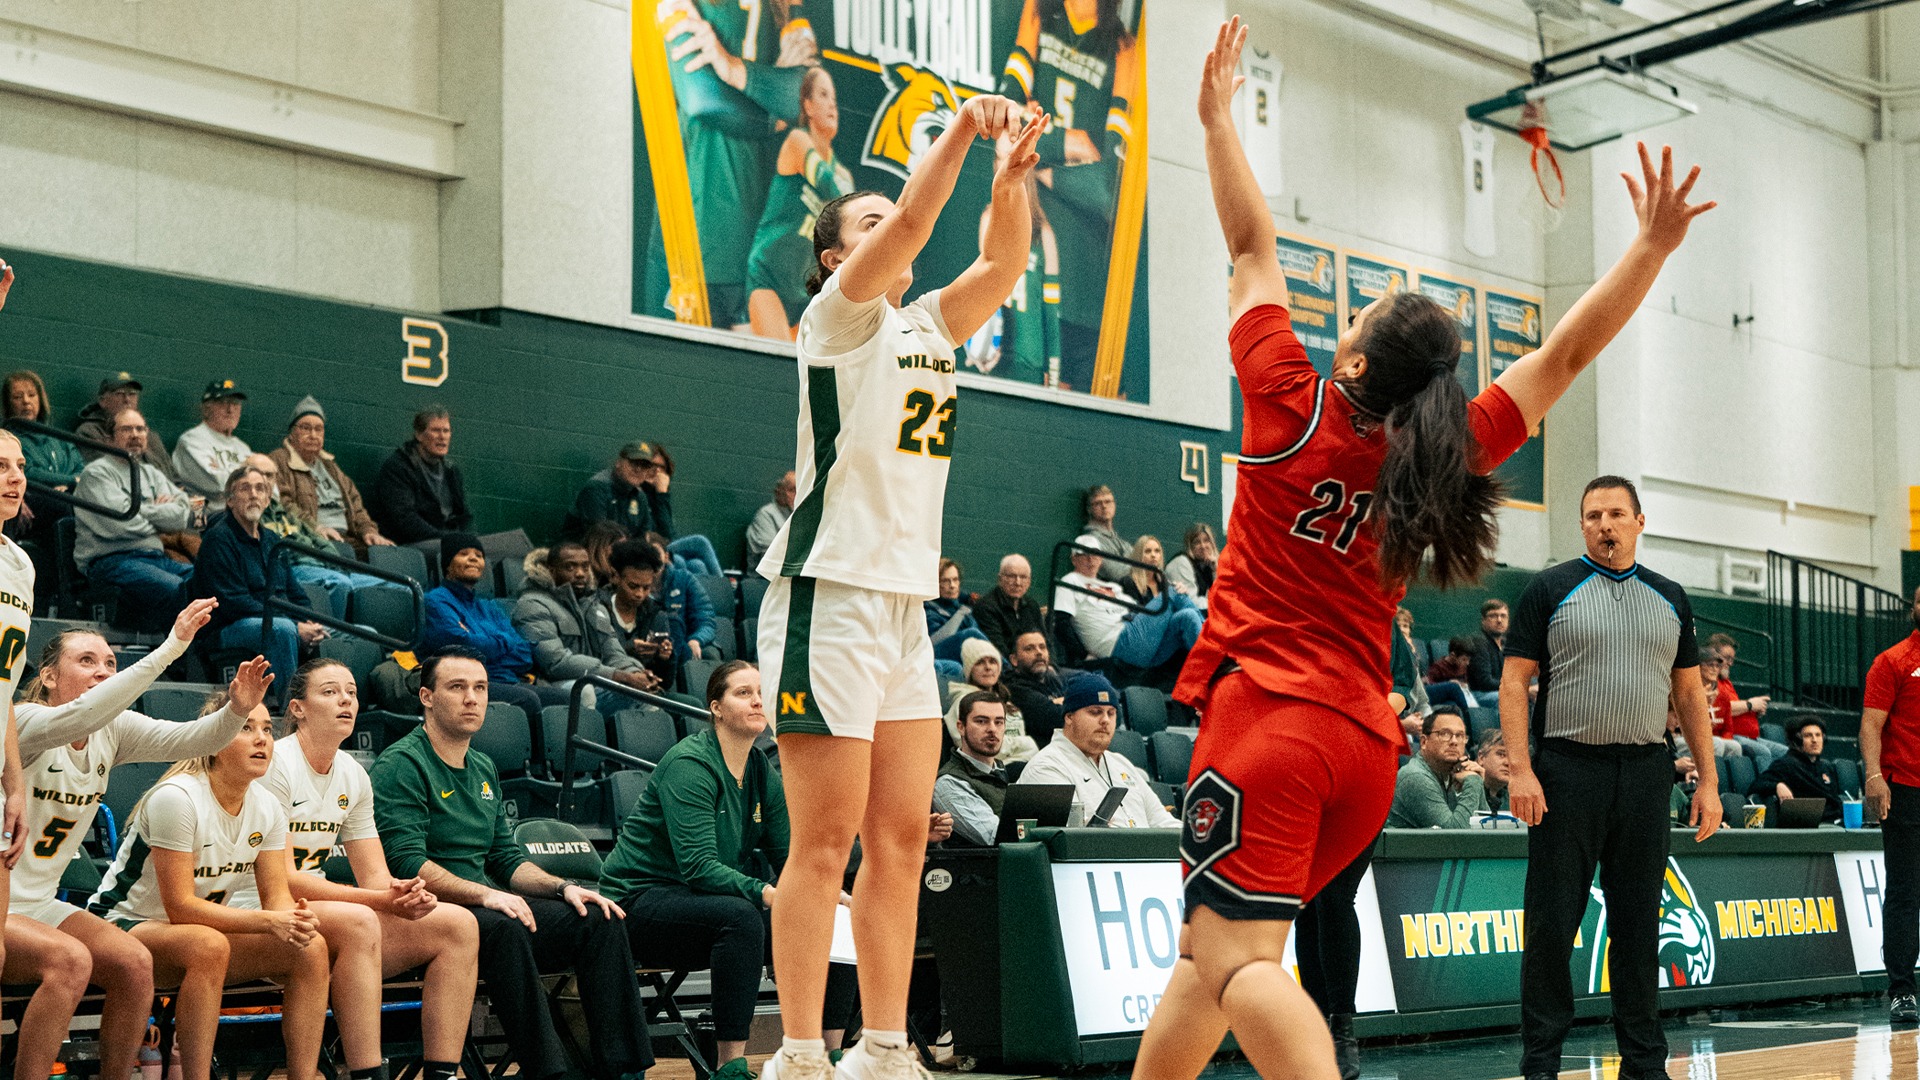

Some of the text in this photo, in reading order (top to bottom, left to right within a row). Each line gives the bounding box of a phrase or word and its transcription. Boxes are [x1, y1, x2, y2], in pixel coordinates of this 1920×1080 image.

[402, 317, 448, 387] 3
[896, 354, 955, 374] WILDC
[896, 388, 957, 460] 23
[1289, 477, 1374, 555] 21
[0, 624, 27, 682] 0
[781, 691, 807, 715] N
[289, 821, 342, 834] ILDCAT
[505, 801, 516, 818] C
[33, 816, 78, 859] 5
[525, 841, 591, 855] WILDCATS
[1856, 859, 1885, 928] H
[1400, 909, 1583, 959] NORTH
[1715, 896, 1838, 940] MICHIGAN
